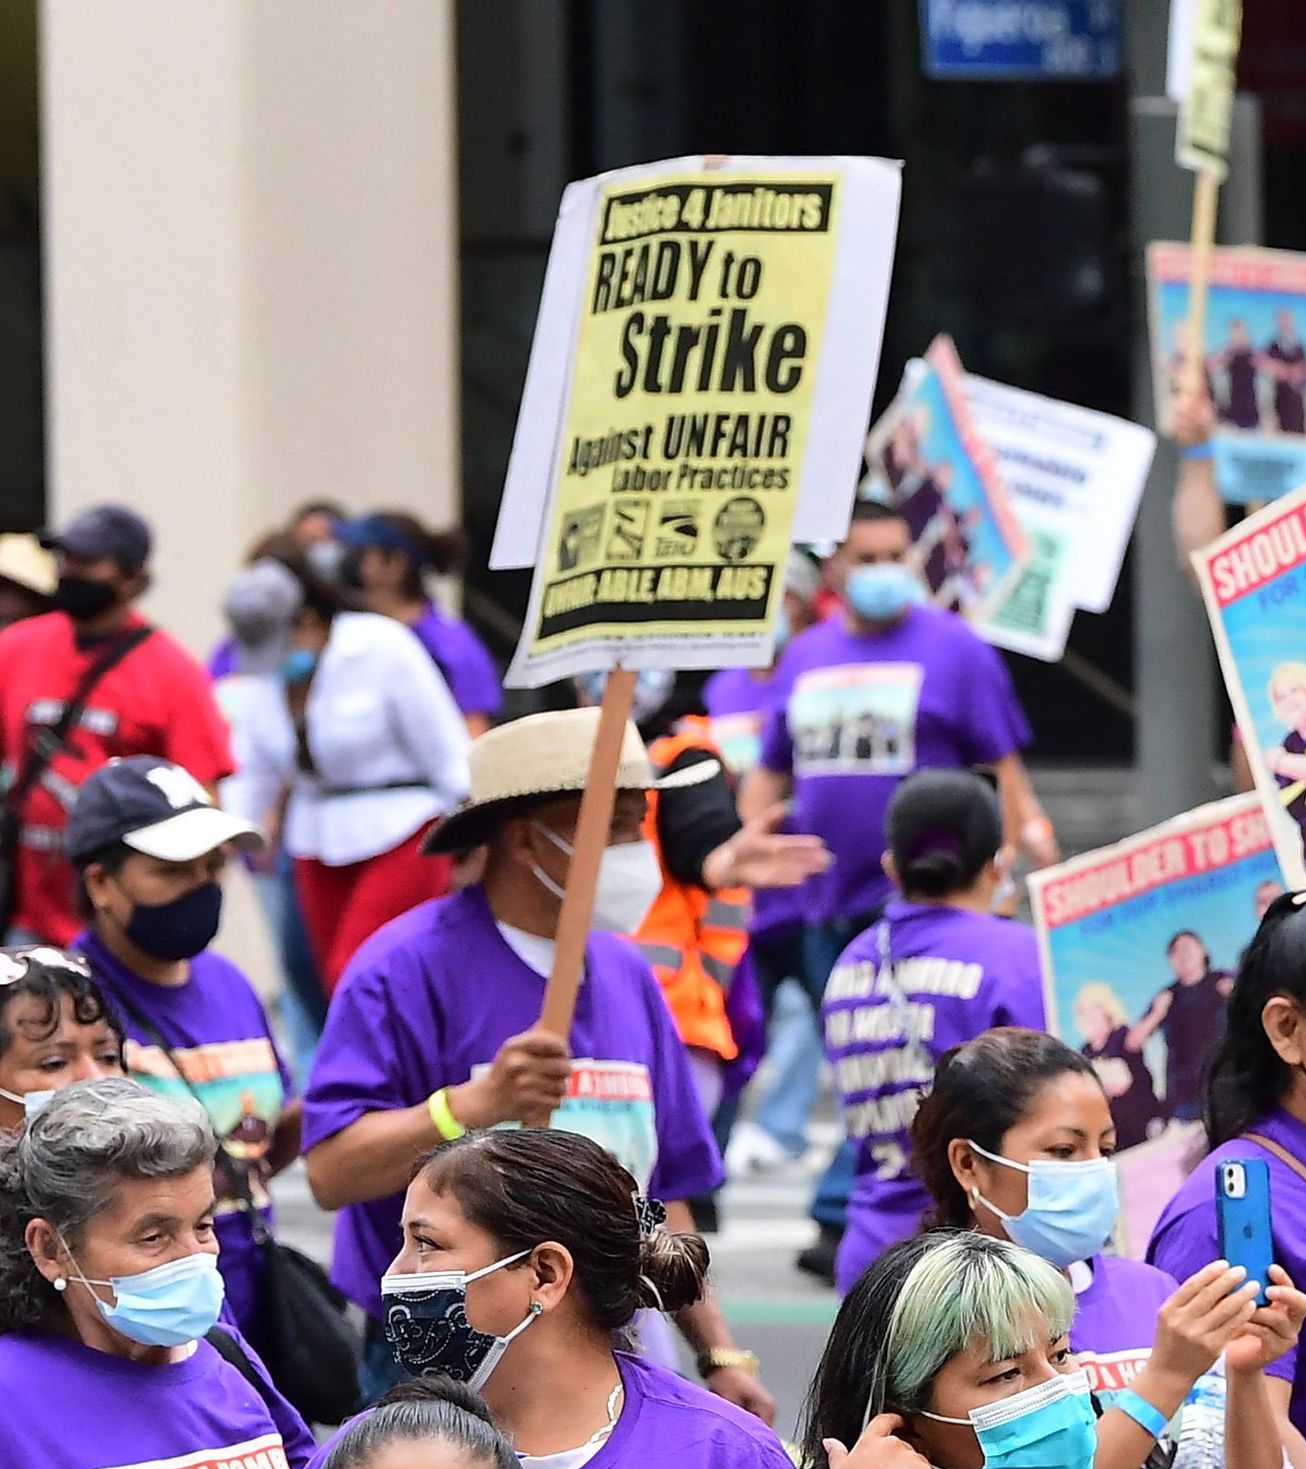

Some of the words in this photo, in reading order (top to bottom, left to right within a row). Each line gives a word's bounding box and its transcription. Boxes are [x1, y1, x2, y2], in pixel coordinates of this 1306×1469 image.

[681, 188, 706, 228] 4
[592, 240, 715, 315] READY
[720, 252, 762, 300] to
[614, 308, 808, 398] Strike
[663, 414, 792, 460] UNFAIR
[676, 463, 791, 490] Practices
